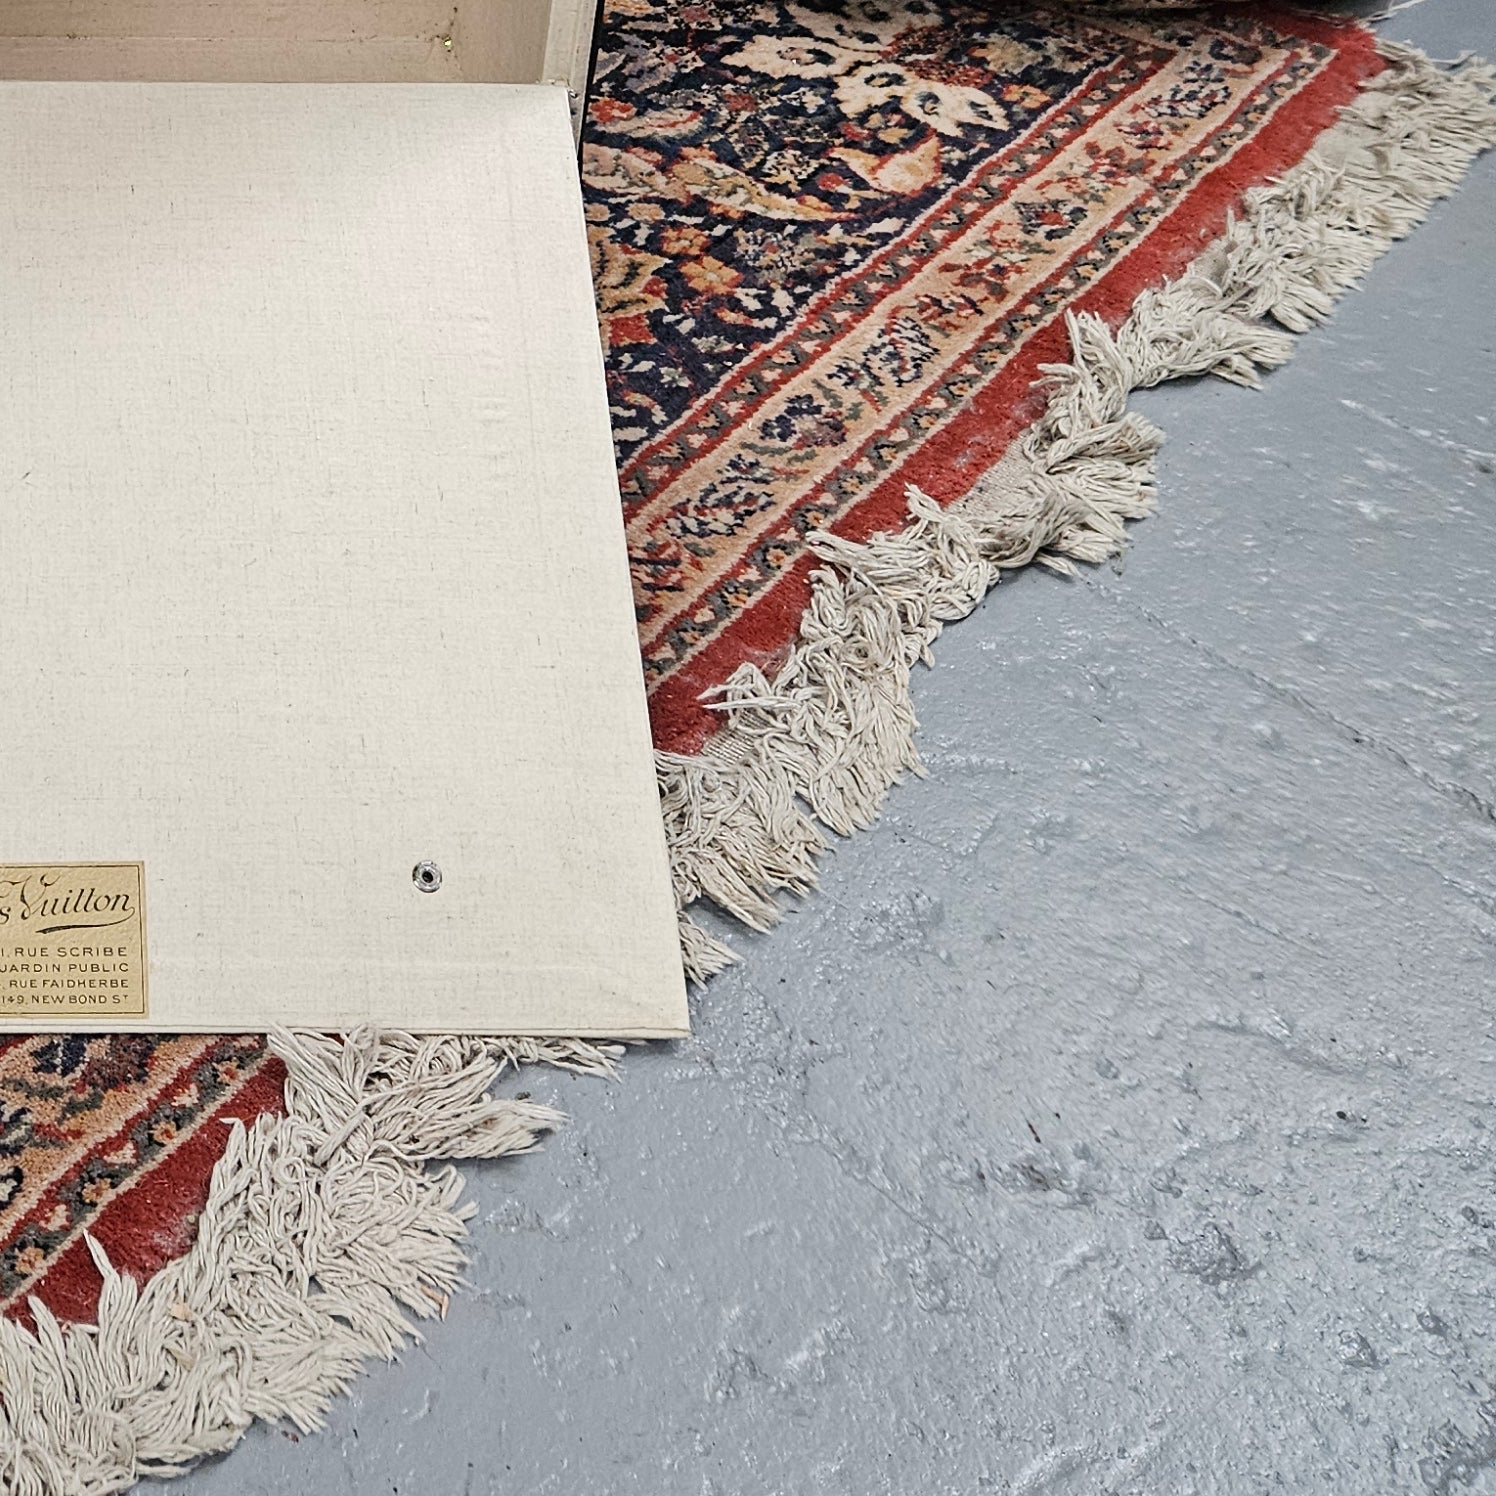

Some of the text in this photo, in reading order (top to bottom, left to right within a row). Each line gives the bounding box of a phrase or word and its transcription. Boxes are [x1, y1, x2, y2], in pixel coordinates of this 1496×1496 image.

[15, 947, 48, 957] RUE
[57, 947, 127, 957] SCRIBE
[0, 963, 61, 972] JARDIN
[69, 963, 128, 972] PUBLIC
[9, 980, 37, 988] RUE
[42, 979, 128, 988] FAIDHERBE
[31, 995, 65, 1004] NEW
[69, 994, 107, 1004] BOND
